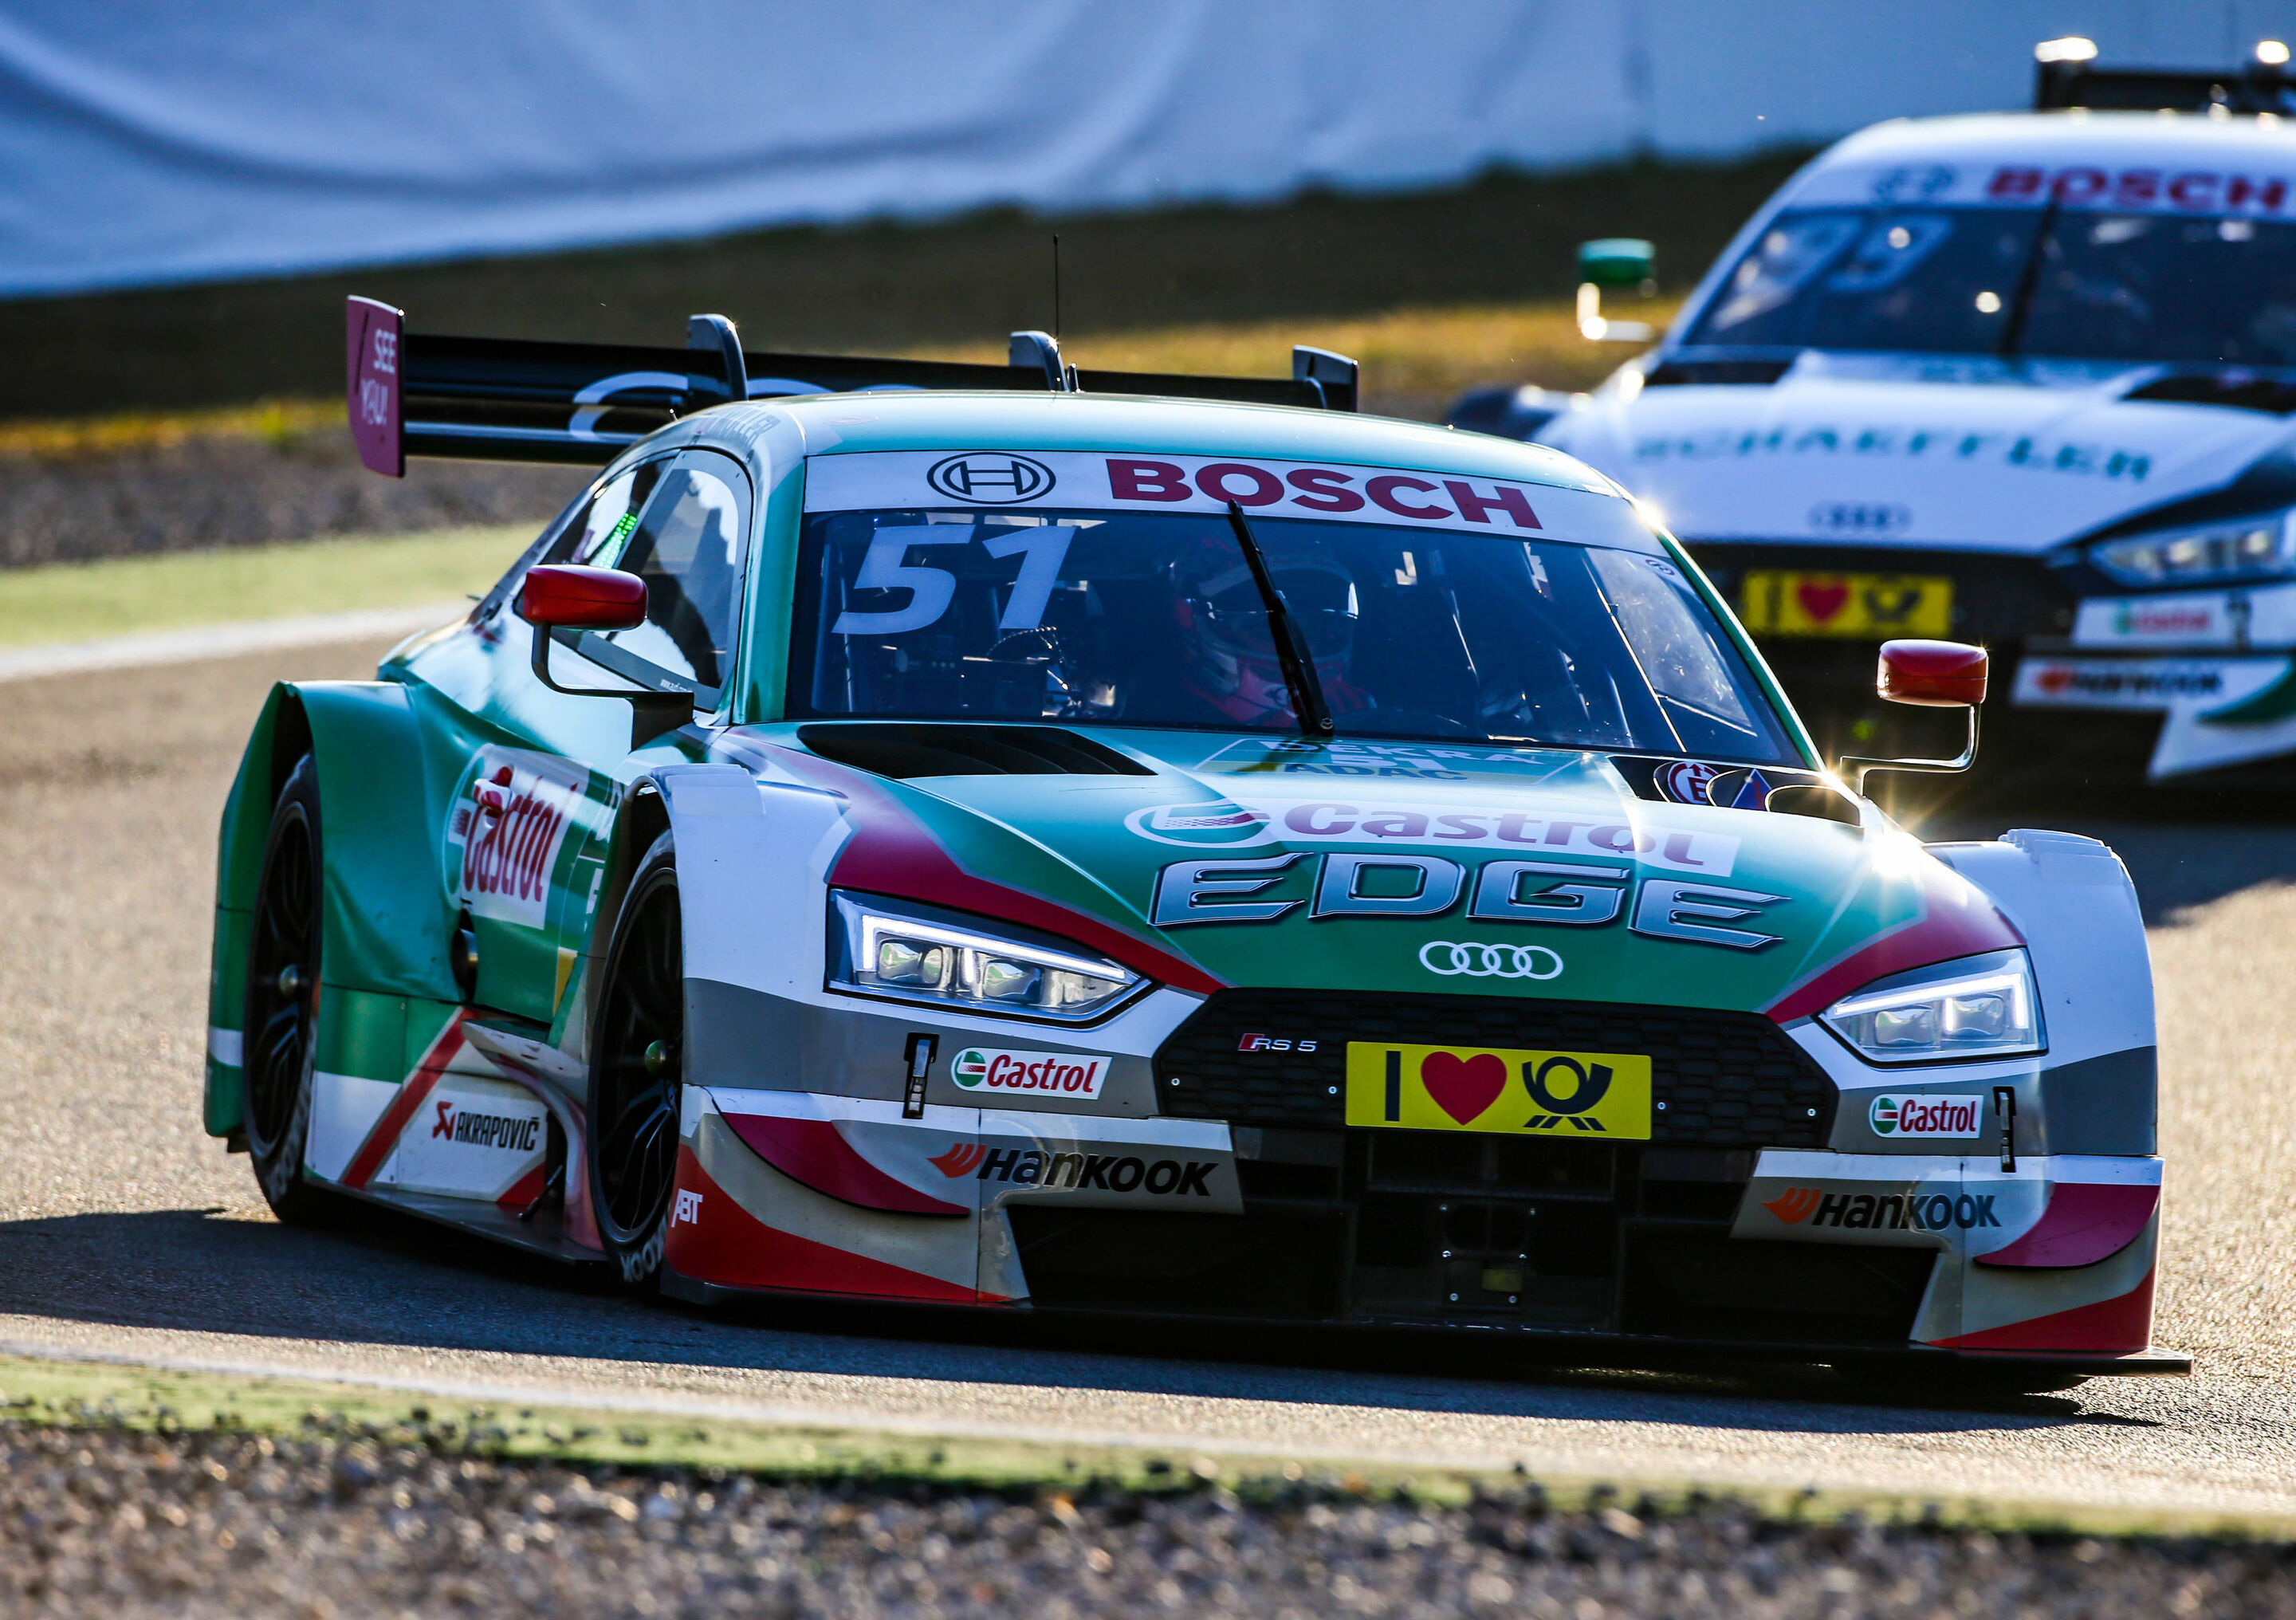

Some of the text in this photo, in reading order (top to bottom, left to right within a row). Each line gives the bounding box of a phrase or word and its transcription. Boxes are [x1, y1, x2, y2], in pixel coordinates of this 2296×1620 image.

[1988, 167, 2287, 210] BOSCH
[374, 328, 397, 374] SEE
[1105, 458, 1543, 529] BOSCH
[831, 524, 1076, 635] 51
[1259, 740, 1546, 765] DEKRA
[1284, 763, 1468, 781] ADAC
[1331, 753, 1448, 771] 51
[1283, 801, 1705, 867] Castrol
[1146, 851, 1792, 950] EDGE
[1250, 1037, 1318, 1052] RS 5
[987, 1054, 1099, 1093] Castrol
[1385, 1050, 1402, 1122] I
[454, 1111, 541, 1152] AKRAPOVIČ
[1899, 1099, 1977, 1132] Castrol
[670, 1188, 703, 1228] ABT
